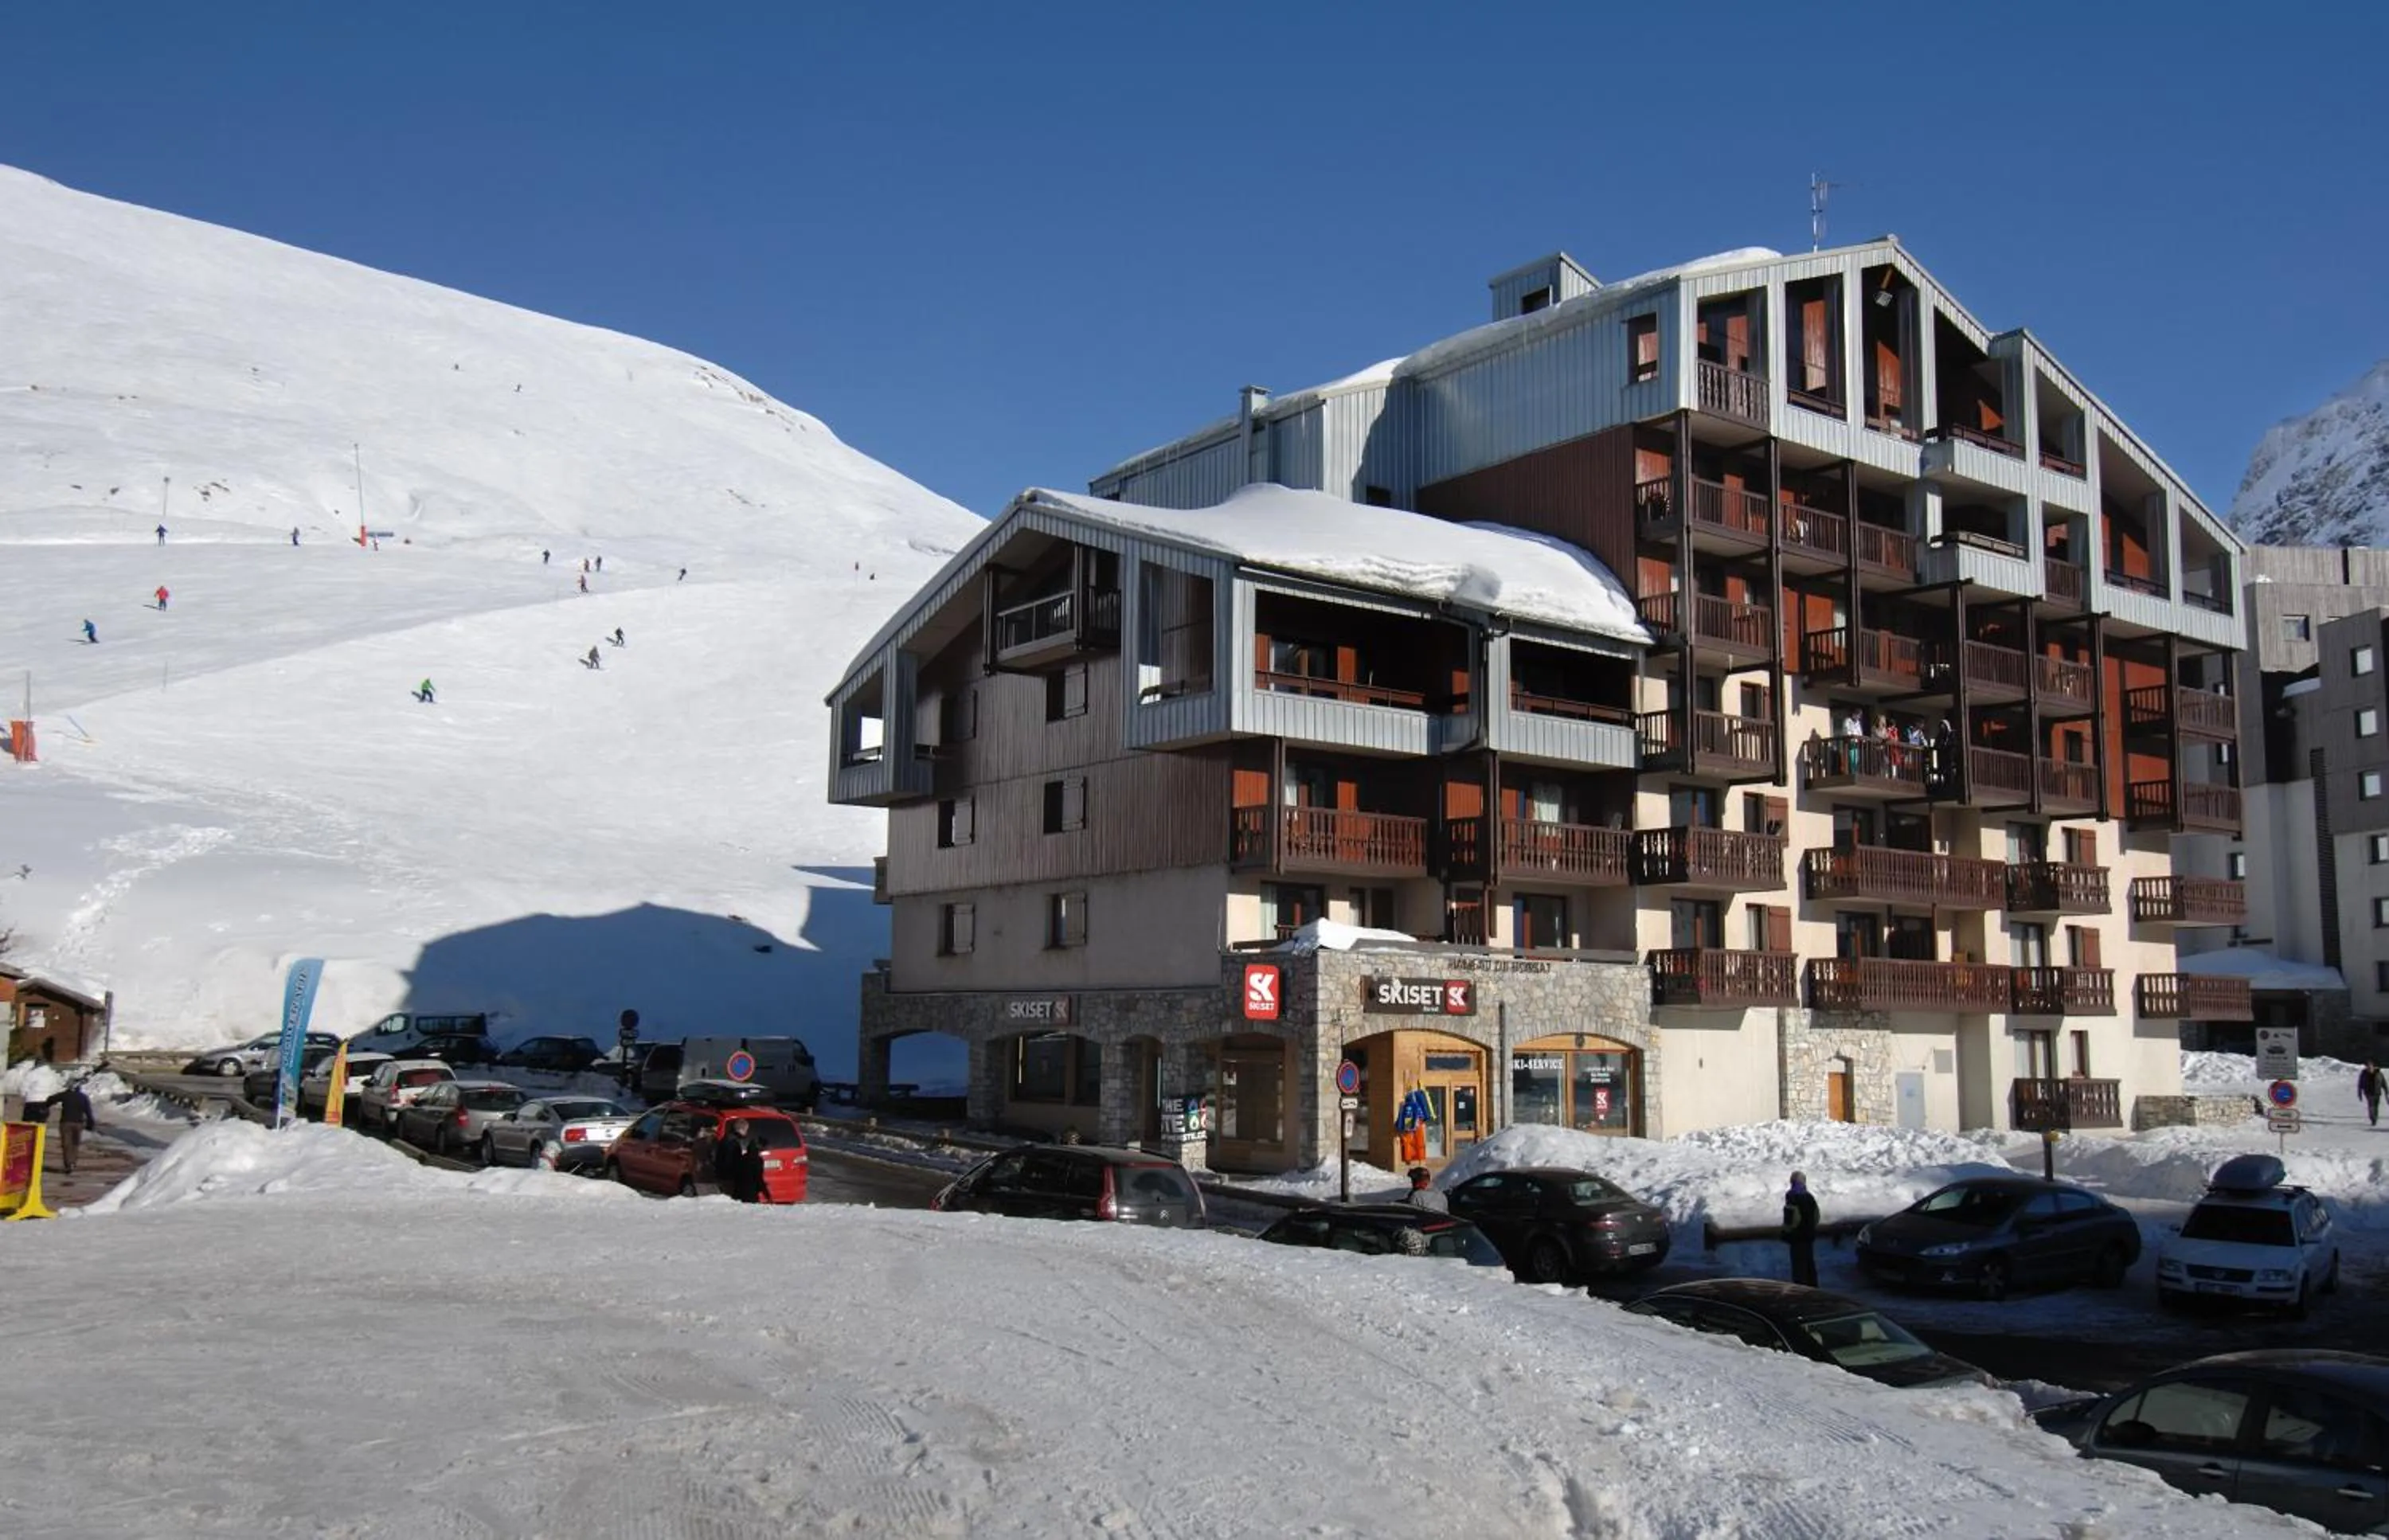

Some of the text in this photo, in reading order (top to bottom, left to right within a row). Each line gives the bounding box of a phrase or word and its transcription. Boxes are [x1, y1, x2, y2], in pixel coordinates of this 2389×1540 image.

[1378, 983, 1443, 1005] SKISET
[1010, 1002, 1052, 1018] SKISET
[1248, 1002, 1275, 1010] SKISET
[1510, 1058, 1563, 1070] KI-SERVICE
